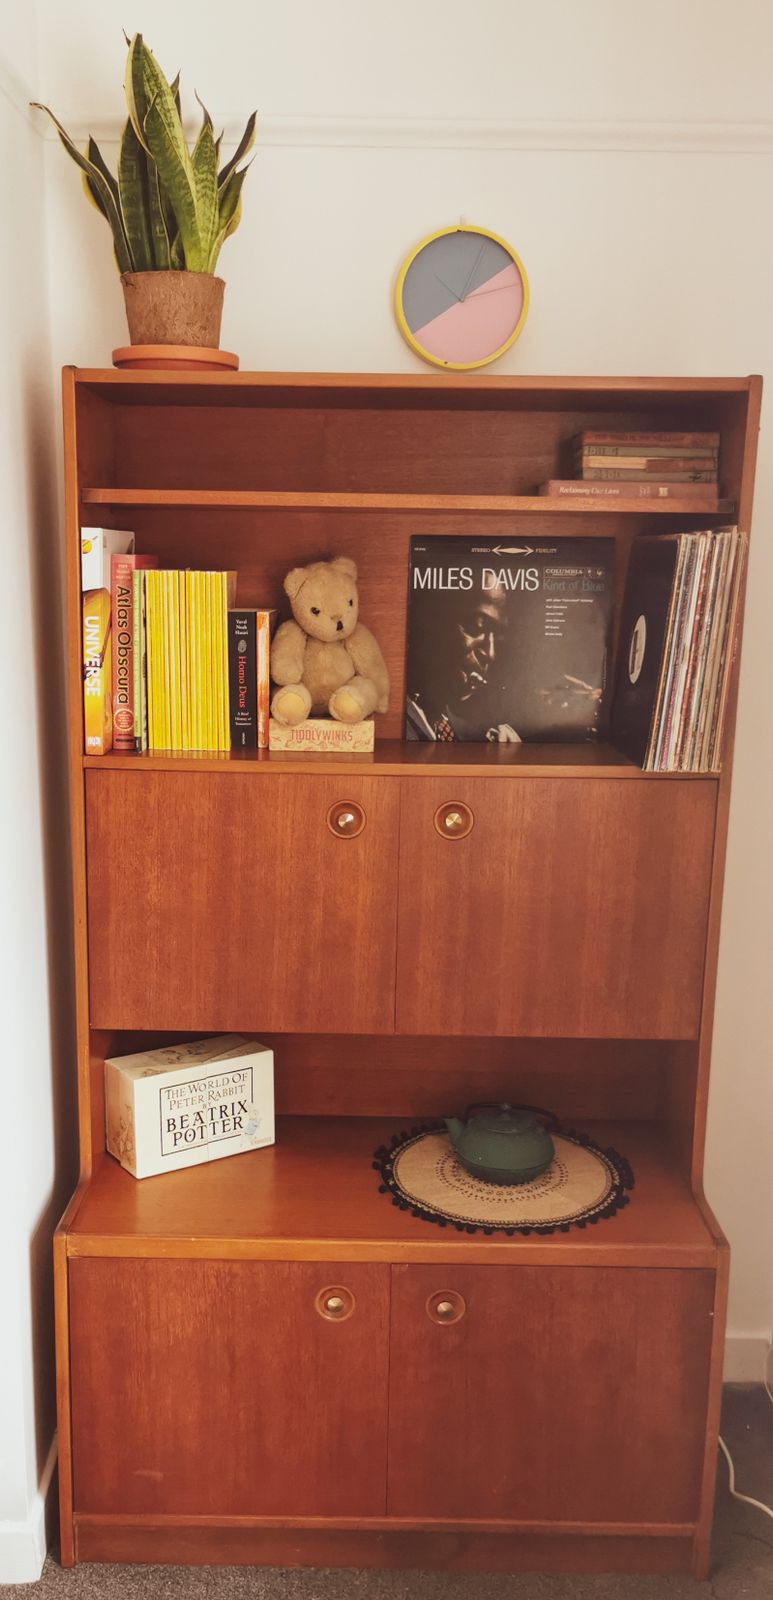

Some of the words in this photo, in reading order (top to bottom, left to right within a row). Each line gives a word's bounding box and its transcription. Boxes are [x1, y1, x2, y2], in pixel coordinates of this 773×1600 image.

[413, 567, 473, 590] MILES
[482, 568, 539, 591] DAVIS
[543, 579, 565, 590] Kind
[568, 580, 578, 591] of
[582, 579, 604, 591] Blue
[117, 586, 131, 628] Atlas
[85, 615, 101, 697] UNIVERSE
[117, 632, 131, 704] Obscura
[239, 656, 247, 684] Homo
[239, 686, 247, 708] Deus
[291, 729, 353, 743] TIDDLYWINKS
[165, 1087, 186, 1100] THE
[188, 1076, 230, 1095] WORLD
[232, 1072, 248, 1084] OF
[169, 1095, 205, 1111] PETER
[207, 1084, 246, 1101] RABBIT
[166, 1099, 248, 1133] BEATRIX
[173, 1116, 244, 1146] POTTER
